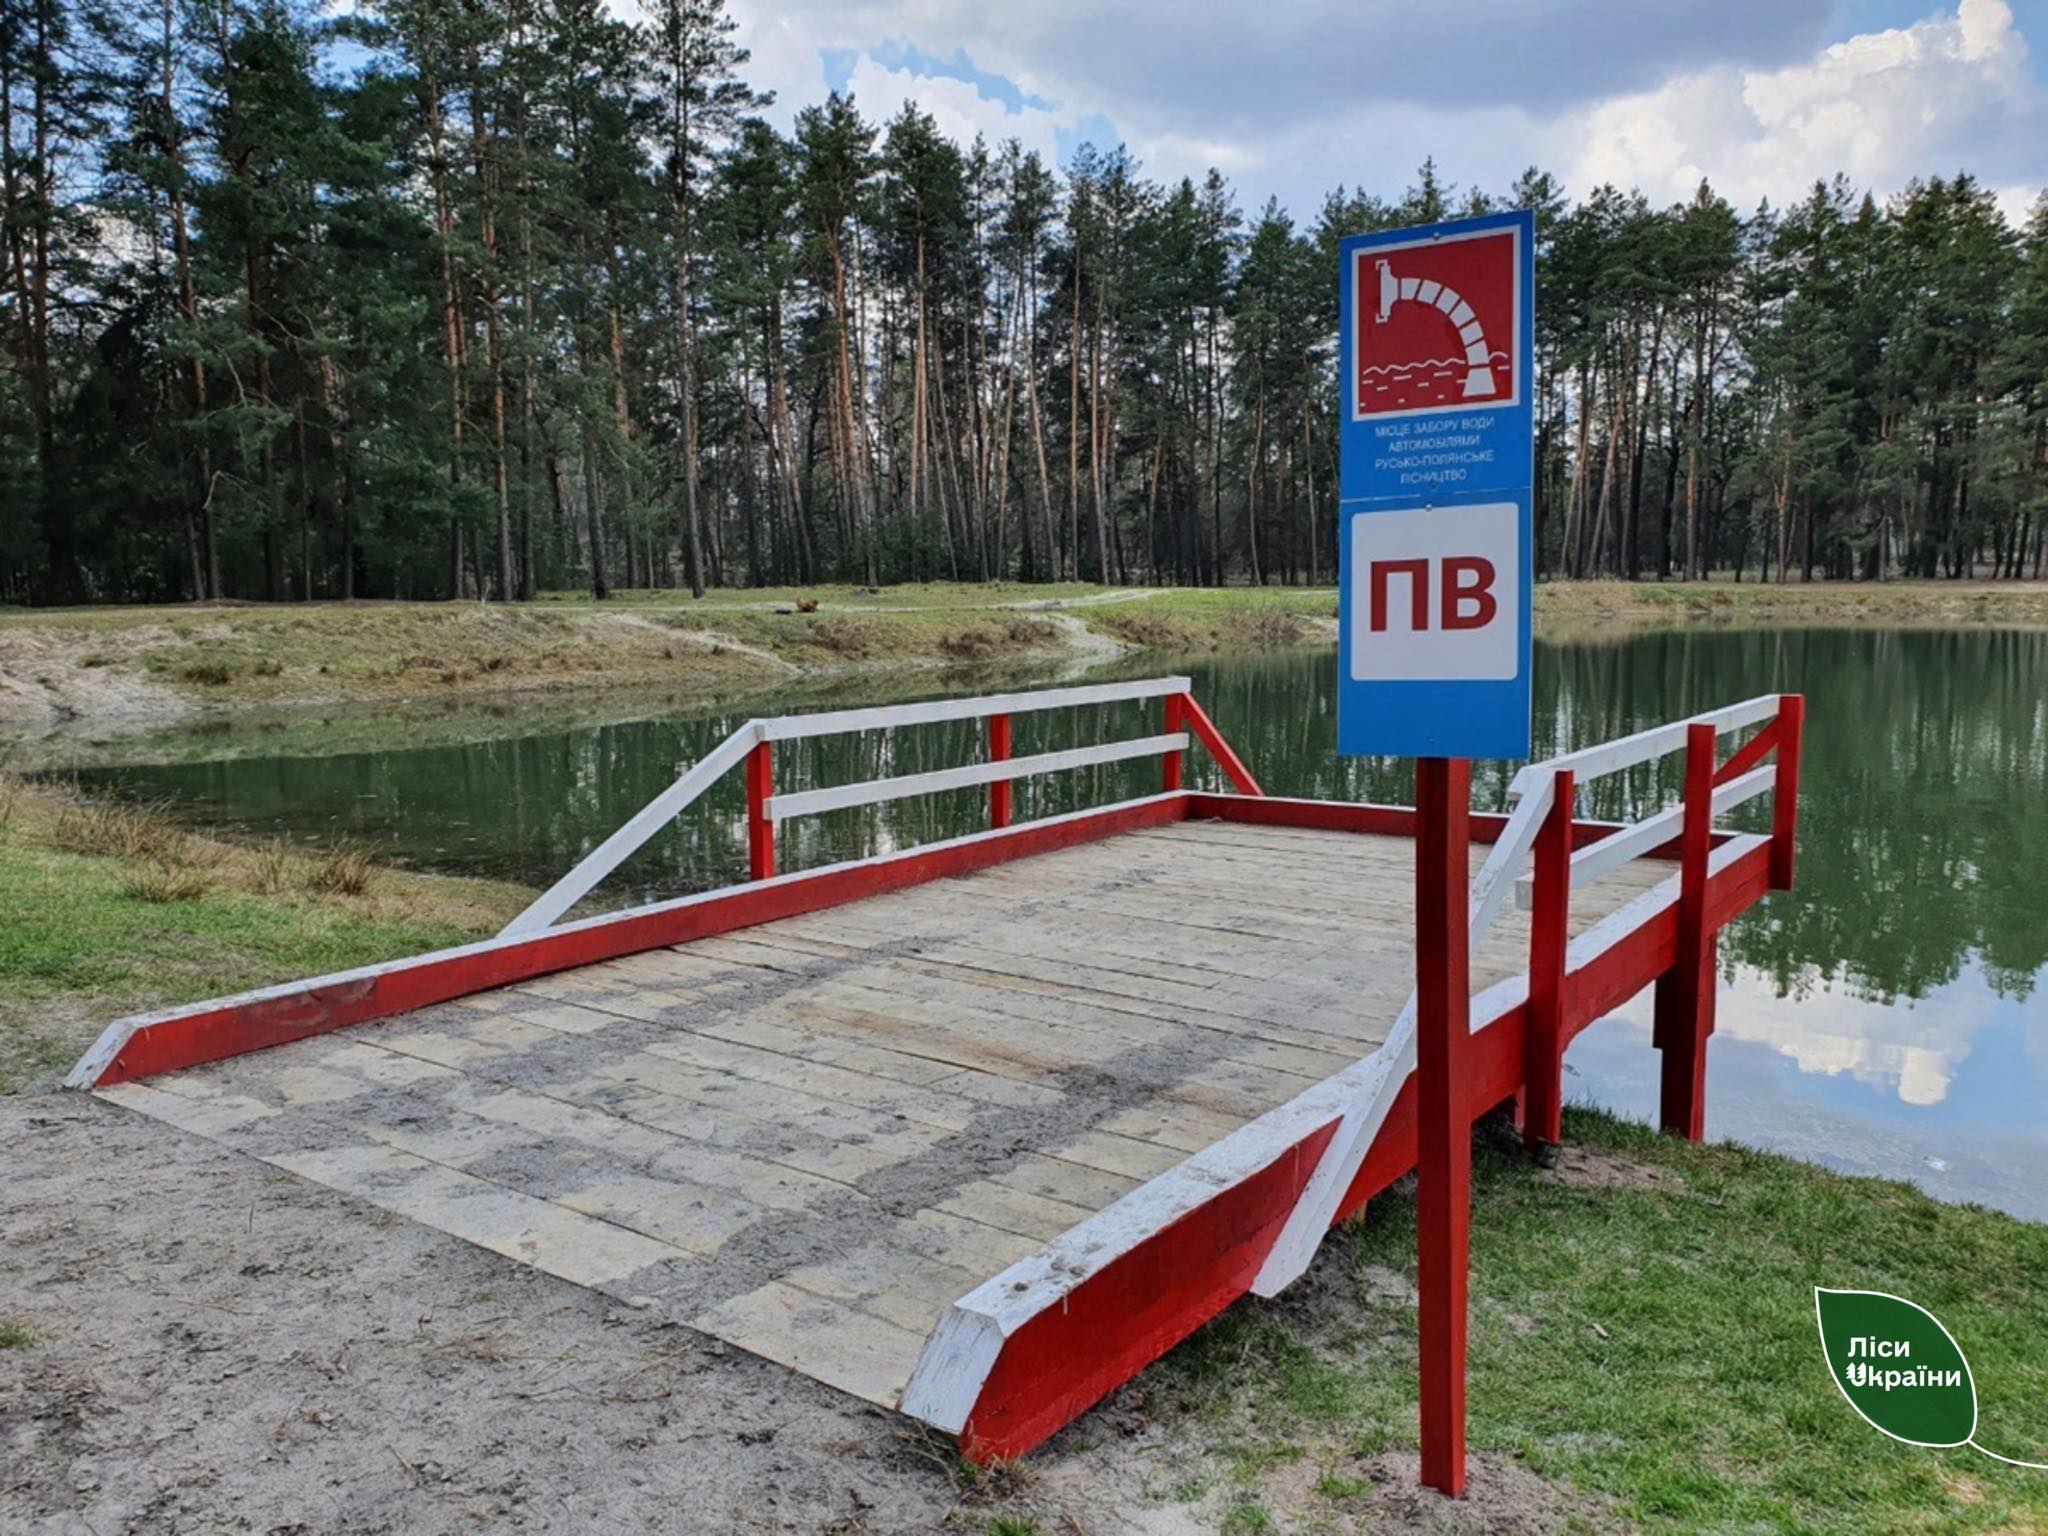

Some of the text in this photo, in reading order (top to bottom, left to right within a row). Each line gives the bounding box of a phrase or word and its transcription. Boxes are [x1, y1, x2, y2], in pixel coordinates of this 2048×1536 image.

[1375, 416, 1495, 437] МІСЦЕ ЗАБОРУ ВОДИ
[1388, 435, 1480, 452] АВТОМОБІЛЯМИ
[1370, 556, 1497, 632] ПВ
